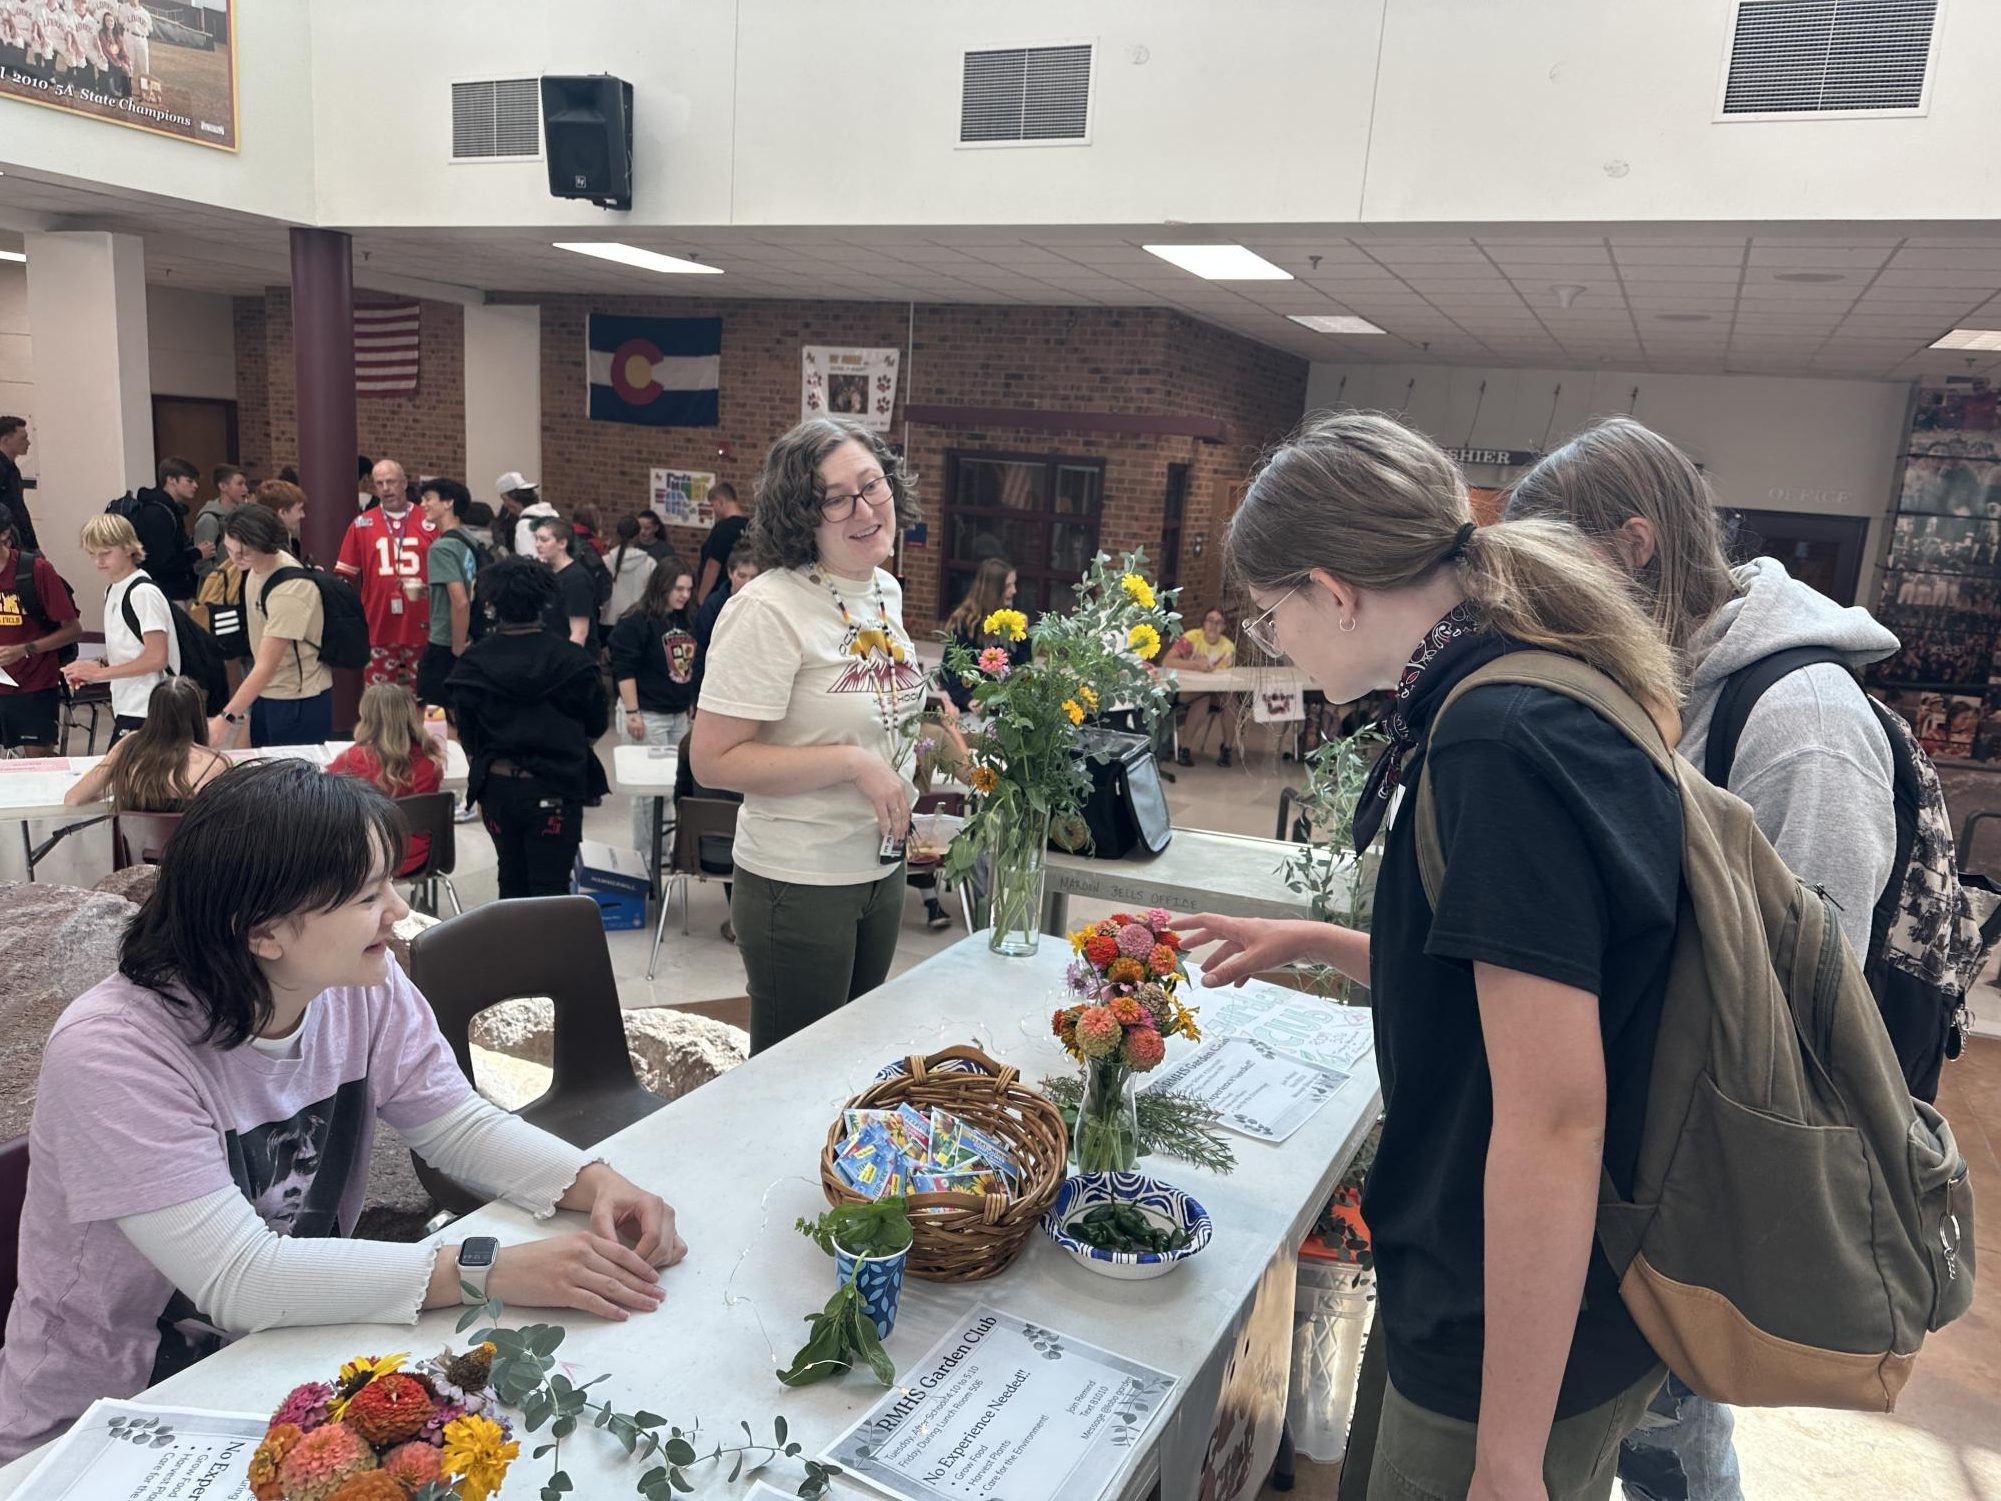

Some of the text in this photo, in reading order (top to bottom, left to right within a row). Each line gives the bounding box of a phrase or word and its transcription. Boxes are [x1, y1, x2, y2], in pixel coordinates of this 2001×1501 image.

[12, 73, 49, 90] 2010
[54, 84, 74, 97] 5A
[80, 88, 116, 108] State
[118, 97, 192, 127] Champions
[1449, 450, 1510, 464] SHIER
[1768, 487, 1853, 504] OFFICE
[375, 537, 420, 576] 15
[875, 1316, 997, 1433] RMHS Garden Club
[1074, 1379, 1096, 1403] Remind
[898, 1448, 922, 1468] Friday
[917, 1424, 943, 1448] During
[937, 1407, 959, 1430] Lunch
[952, 1392, 973, 1409] Room
[923, 1369, 1031, 1486] No Experience Needed!!
[1080, 1413, 1106, 1440] Message
[160, 1453, 193, 1485] Harvest
[220, 1441, 247, 1460] No
[955, 1444, 988, 1480] Grow Food
[968, 1440, 1011, 1486] Harvest Plants
[130, 1452, 175, 1499] Care for the
[168, 1454, 208, 1498] Grow Food
[983, 1475, 1001, 1491] Care
[995, 1464, 1008, 1476] for
[1004, 1454, 1017, 1465] the
